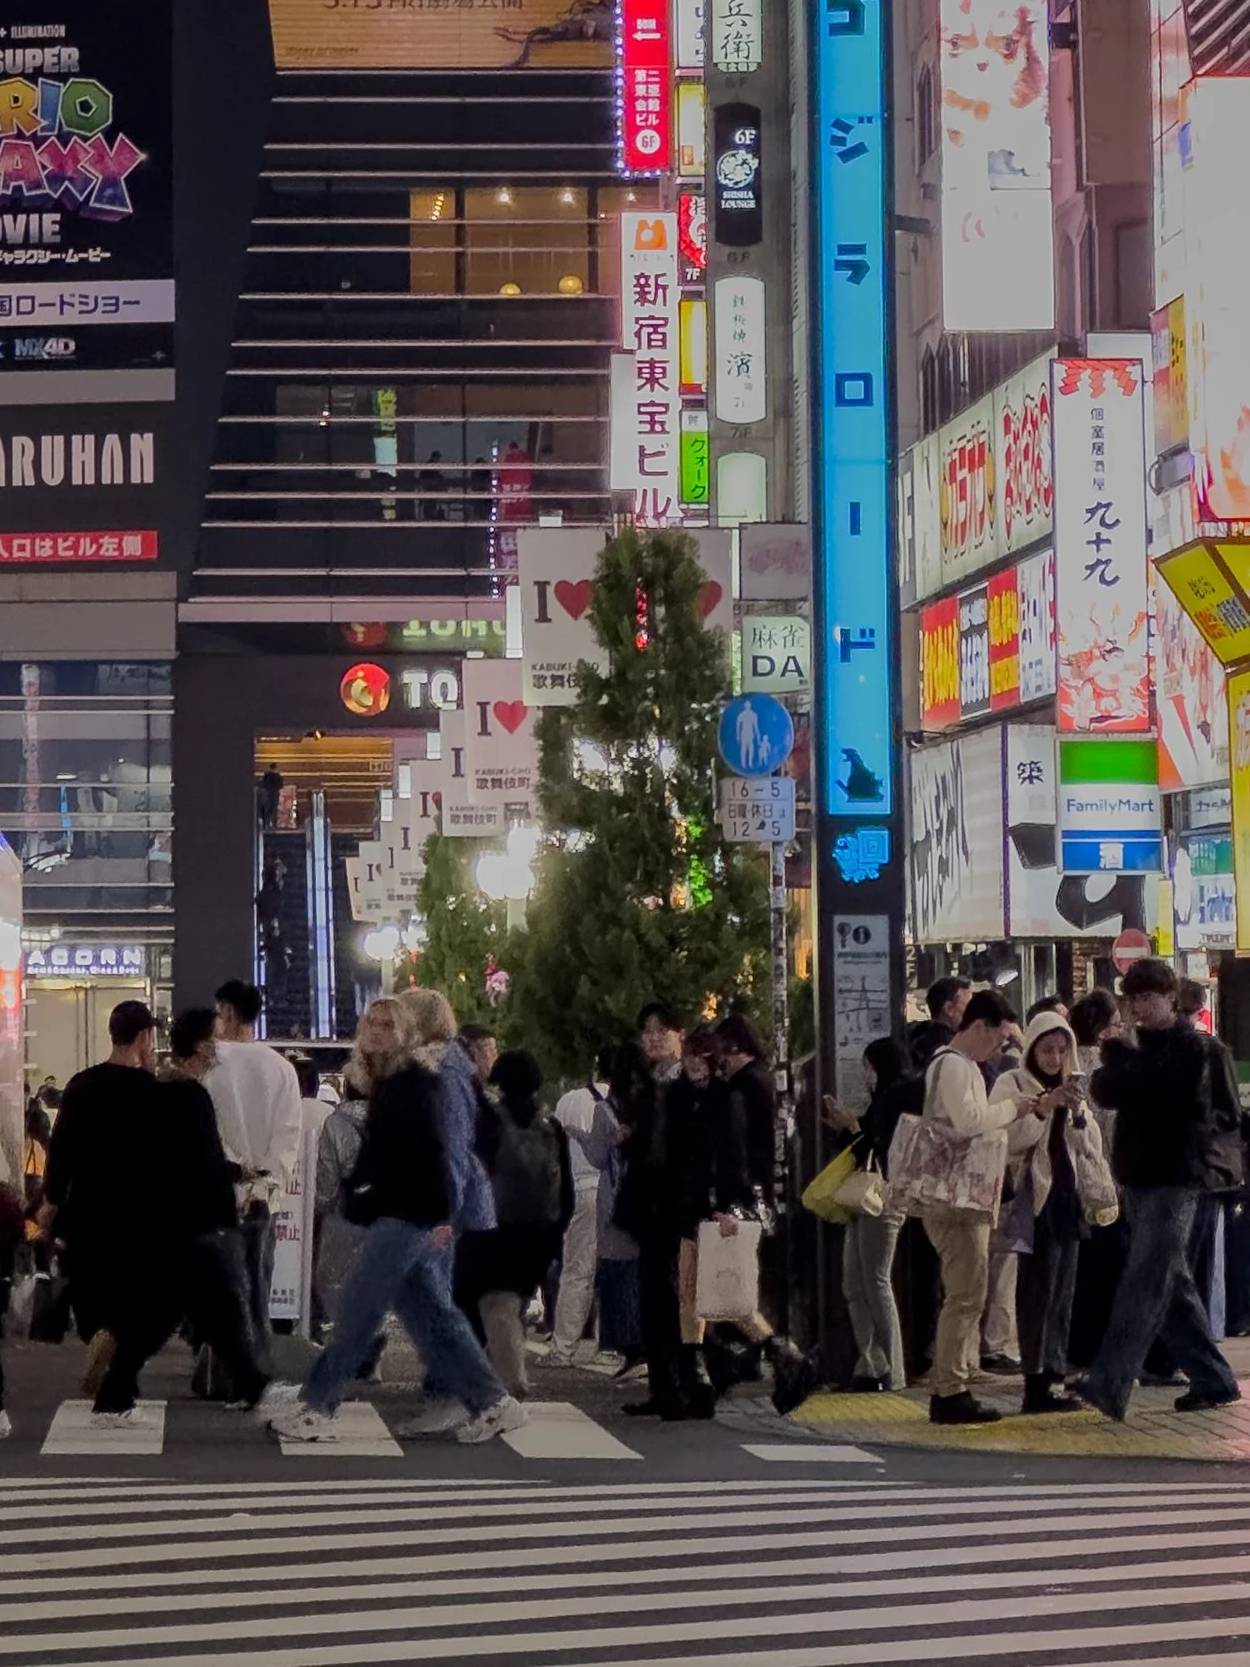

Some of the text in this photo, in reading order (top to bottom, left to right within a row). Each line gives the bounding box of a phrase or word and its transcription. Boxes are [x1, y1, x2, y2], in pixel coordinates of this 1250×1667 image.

[734, 130, 757, 145] 6F
[633, 270, 671, 524] 新宿東宝ビル
[1083, 502, 1121, 587] 九十九
[534, 580, 552, 623] I
[752, 624, 805, 650] 麻雀
[752, 655, 805, 679] DA
[477, 701, 492, 736] I
[451, 747, 465, 778] I
[475, 777, 531, 791] 歌舞伎町
[419, 791, 431, 818] I
[1066, 797, 1155, 817] FamilyMart
[27, 948, 142, 967] ACORN
